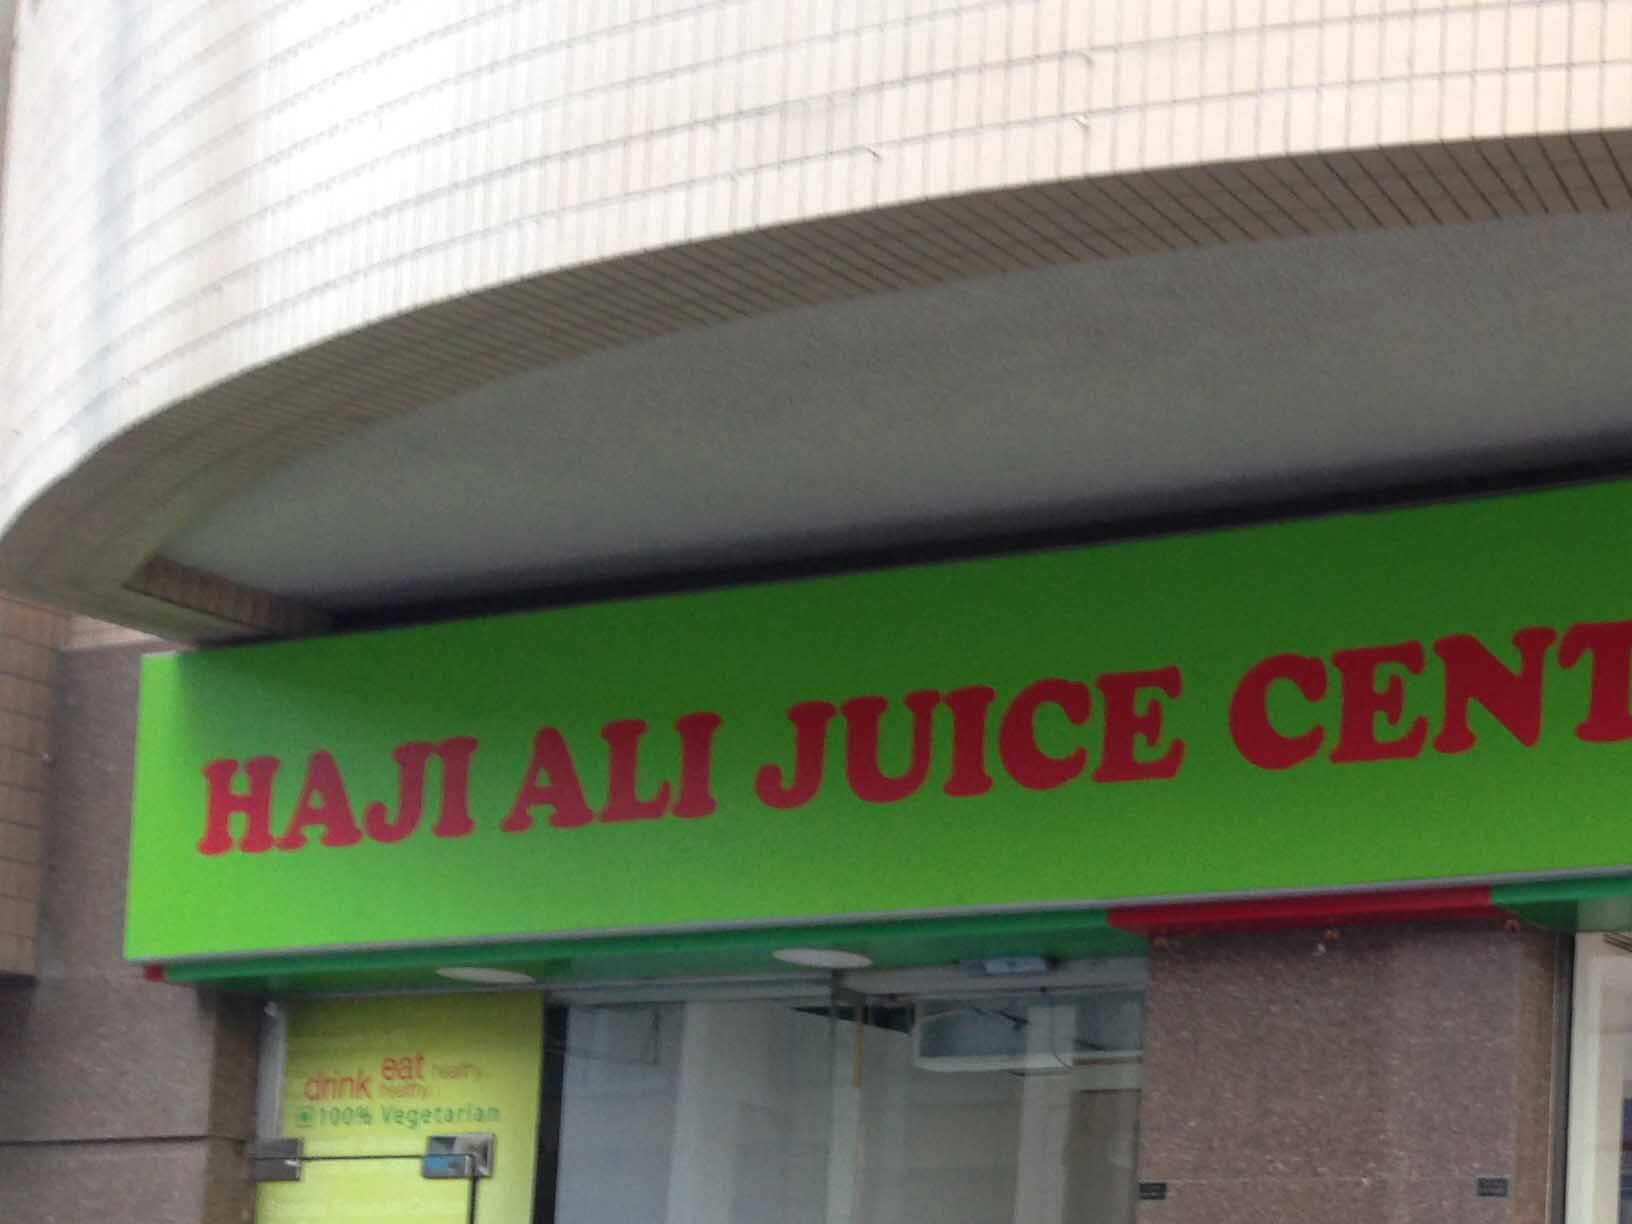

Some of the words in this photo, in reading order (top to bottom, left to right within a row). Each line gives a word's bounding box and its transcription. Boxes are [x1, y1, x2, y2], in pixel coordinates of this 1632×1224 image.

[198, 737, 478, 855] HAJI
[501, 713, 721, 832] ALI
[756, 666, 1184, 809] JUICE
[381, 1050, 425, 1082] eat
[303, 1068, 372, 1102] drink
[318, 1104, 373, 1127] 100%
[380, 1102, 501, 1130] Vegetarian
